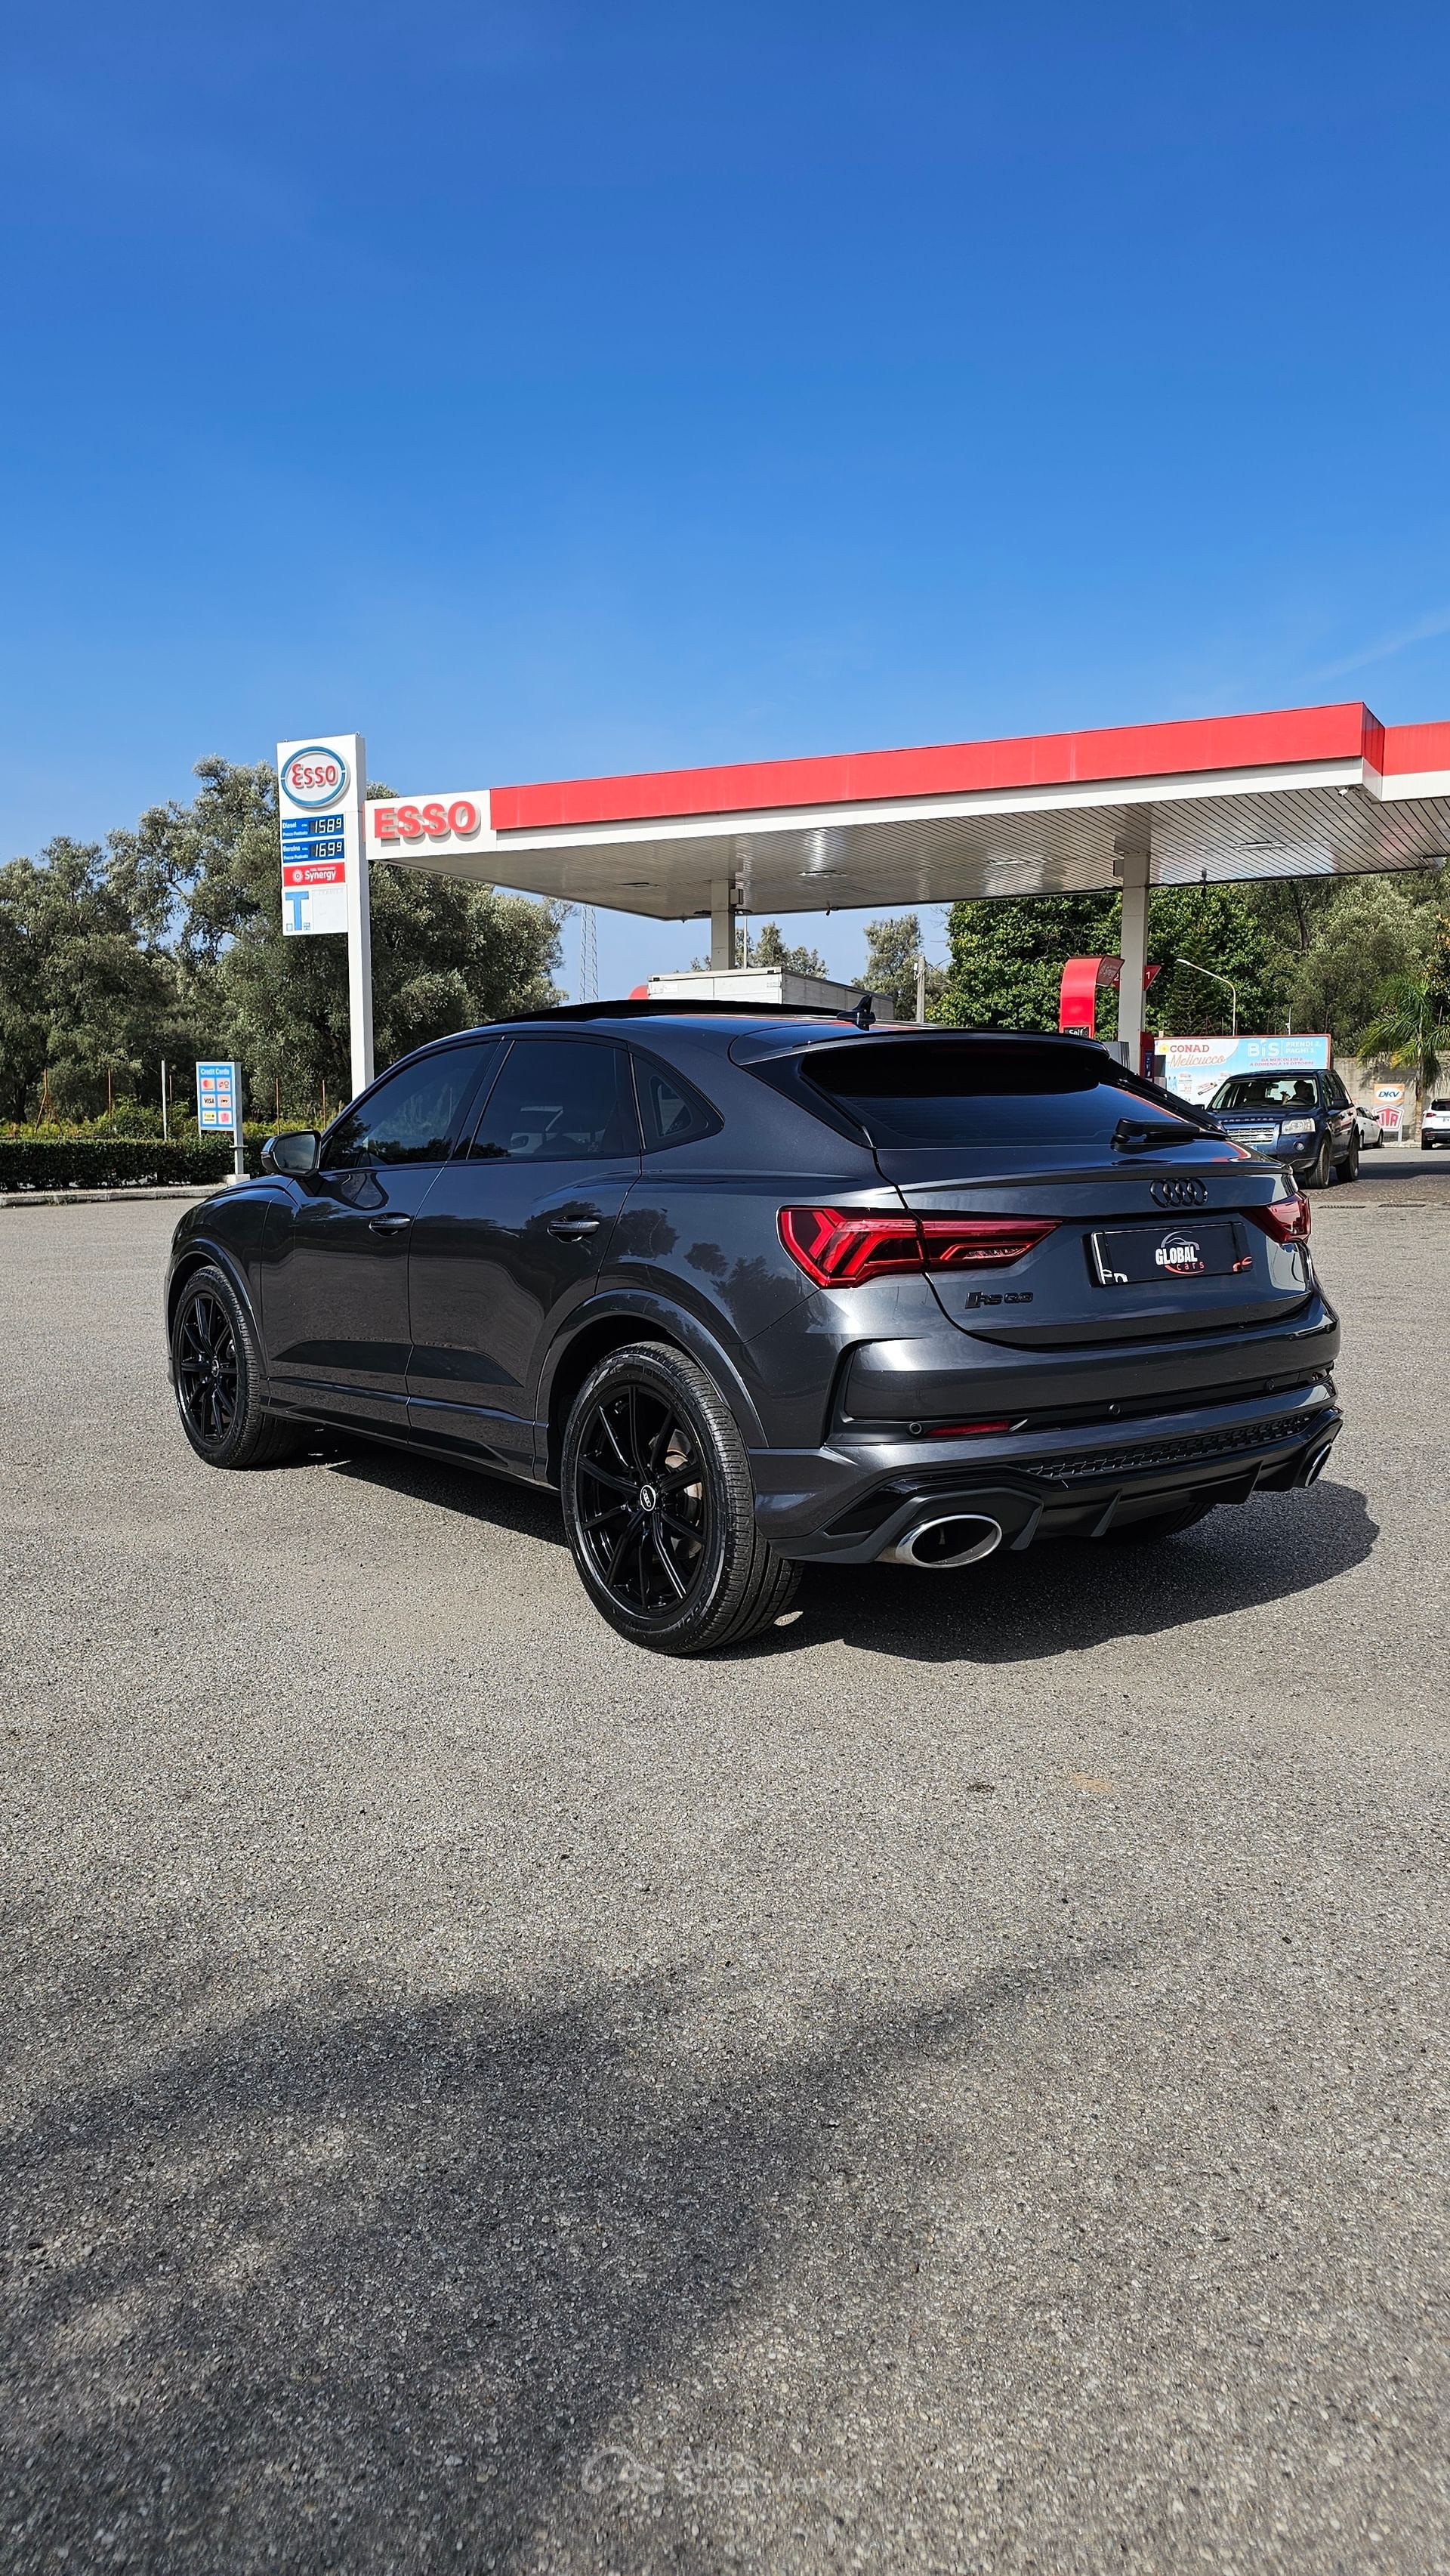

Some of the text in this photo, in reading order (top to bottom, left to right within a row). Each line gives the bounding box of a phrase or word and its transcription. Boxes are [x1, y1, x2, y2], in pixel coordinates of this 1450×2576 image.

[375, 801, 477, 839] ESSO
[304, 869, 336, 882] Synergy
[1170, 1044, 1210, 1052] CONAD
[1169, 1054, 1226, 1067] Melicucco
[1155, 1246, 1198, 1265] GLOBAL
[1176, 1261, 1205, 1271] cars
